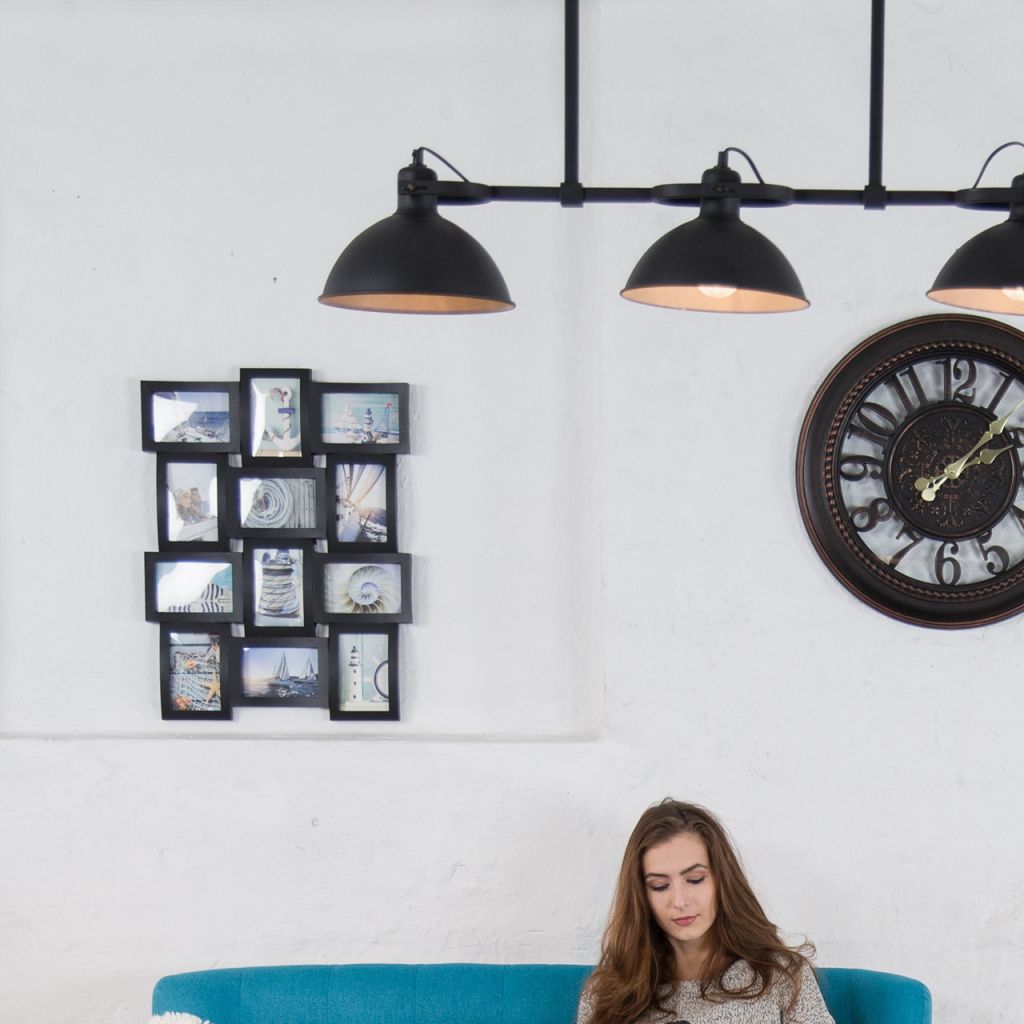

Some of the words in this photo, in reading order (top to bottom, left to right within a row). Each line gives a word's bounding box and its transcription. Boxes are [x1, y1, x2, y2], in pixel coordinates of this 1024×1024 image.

[884, 366, 928, 412] 11
[935, 358, 977, 404] 12
[988, 371, 1015, 413] 1
[847, 401, 899, 447] 10
[839, 455, 882, 482] 9
[851, 498, 894, 533] 8
[889, 524, 924, 568] 7
[934, 541, 962, 586] 6
[976, 530, 1010, 577] 5
